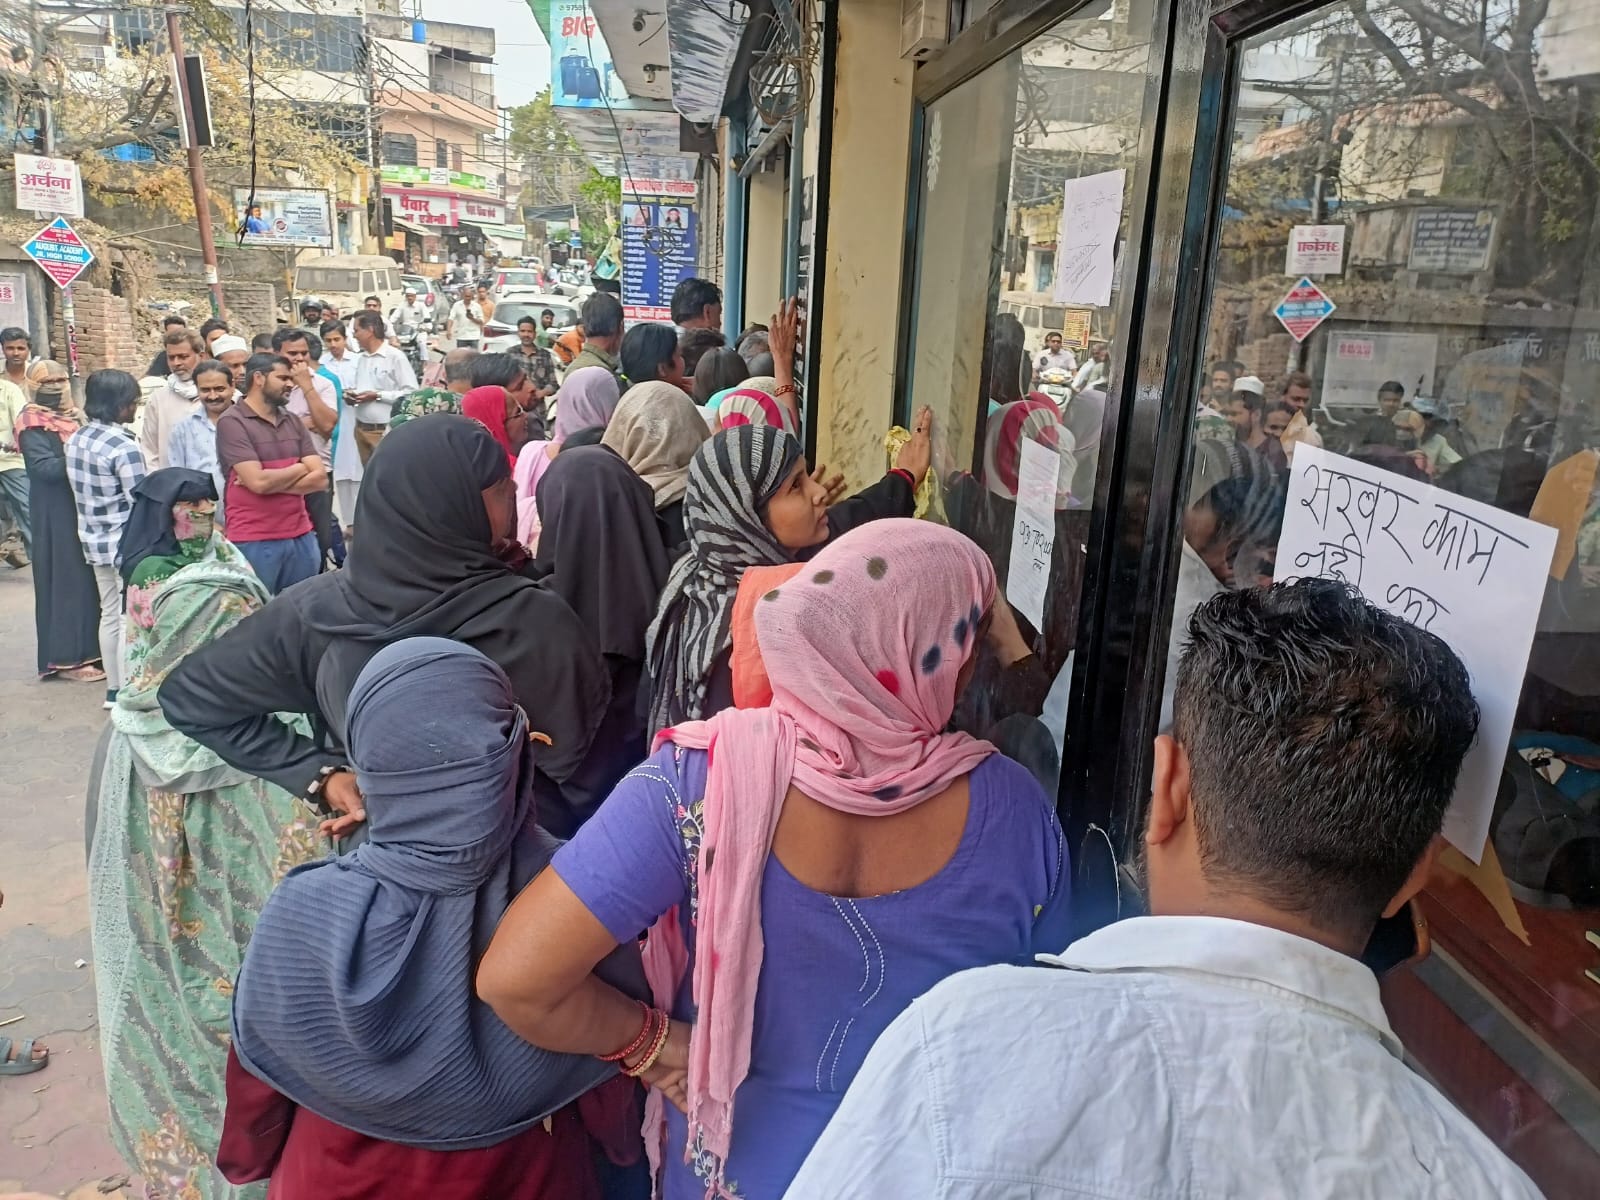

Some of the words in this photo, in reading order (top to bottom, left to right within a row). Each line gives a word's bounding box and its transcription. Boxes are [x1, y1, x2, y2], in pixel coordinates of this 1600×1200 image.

[562, 16, 595, 38] BIG
[20, 171, 71, 190] अर्चना
[47, 252, 63, 260] HIGH
[64, 254, 84, 262] SCHOOL
[60, 245, 84, 256] ACADEMY
[1422, 504, 1529, 586] काम
